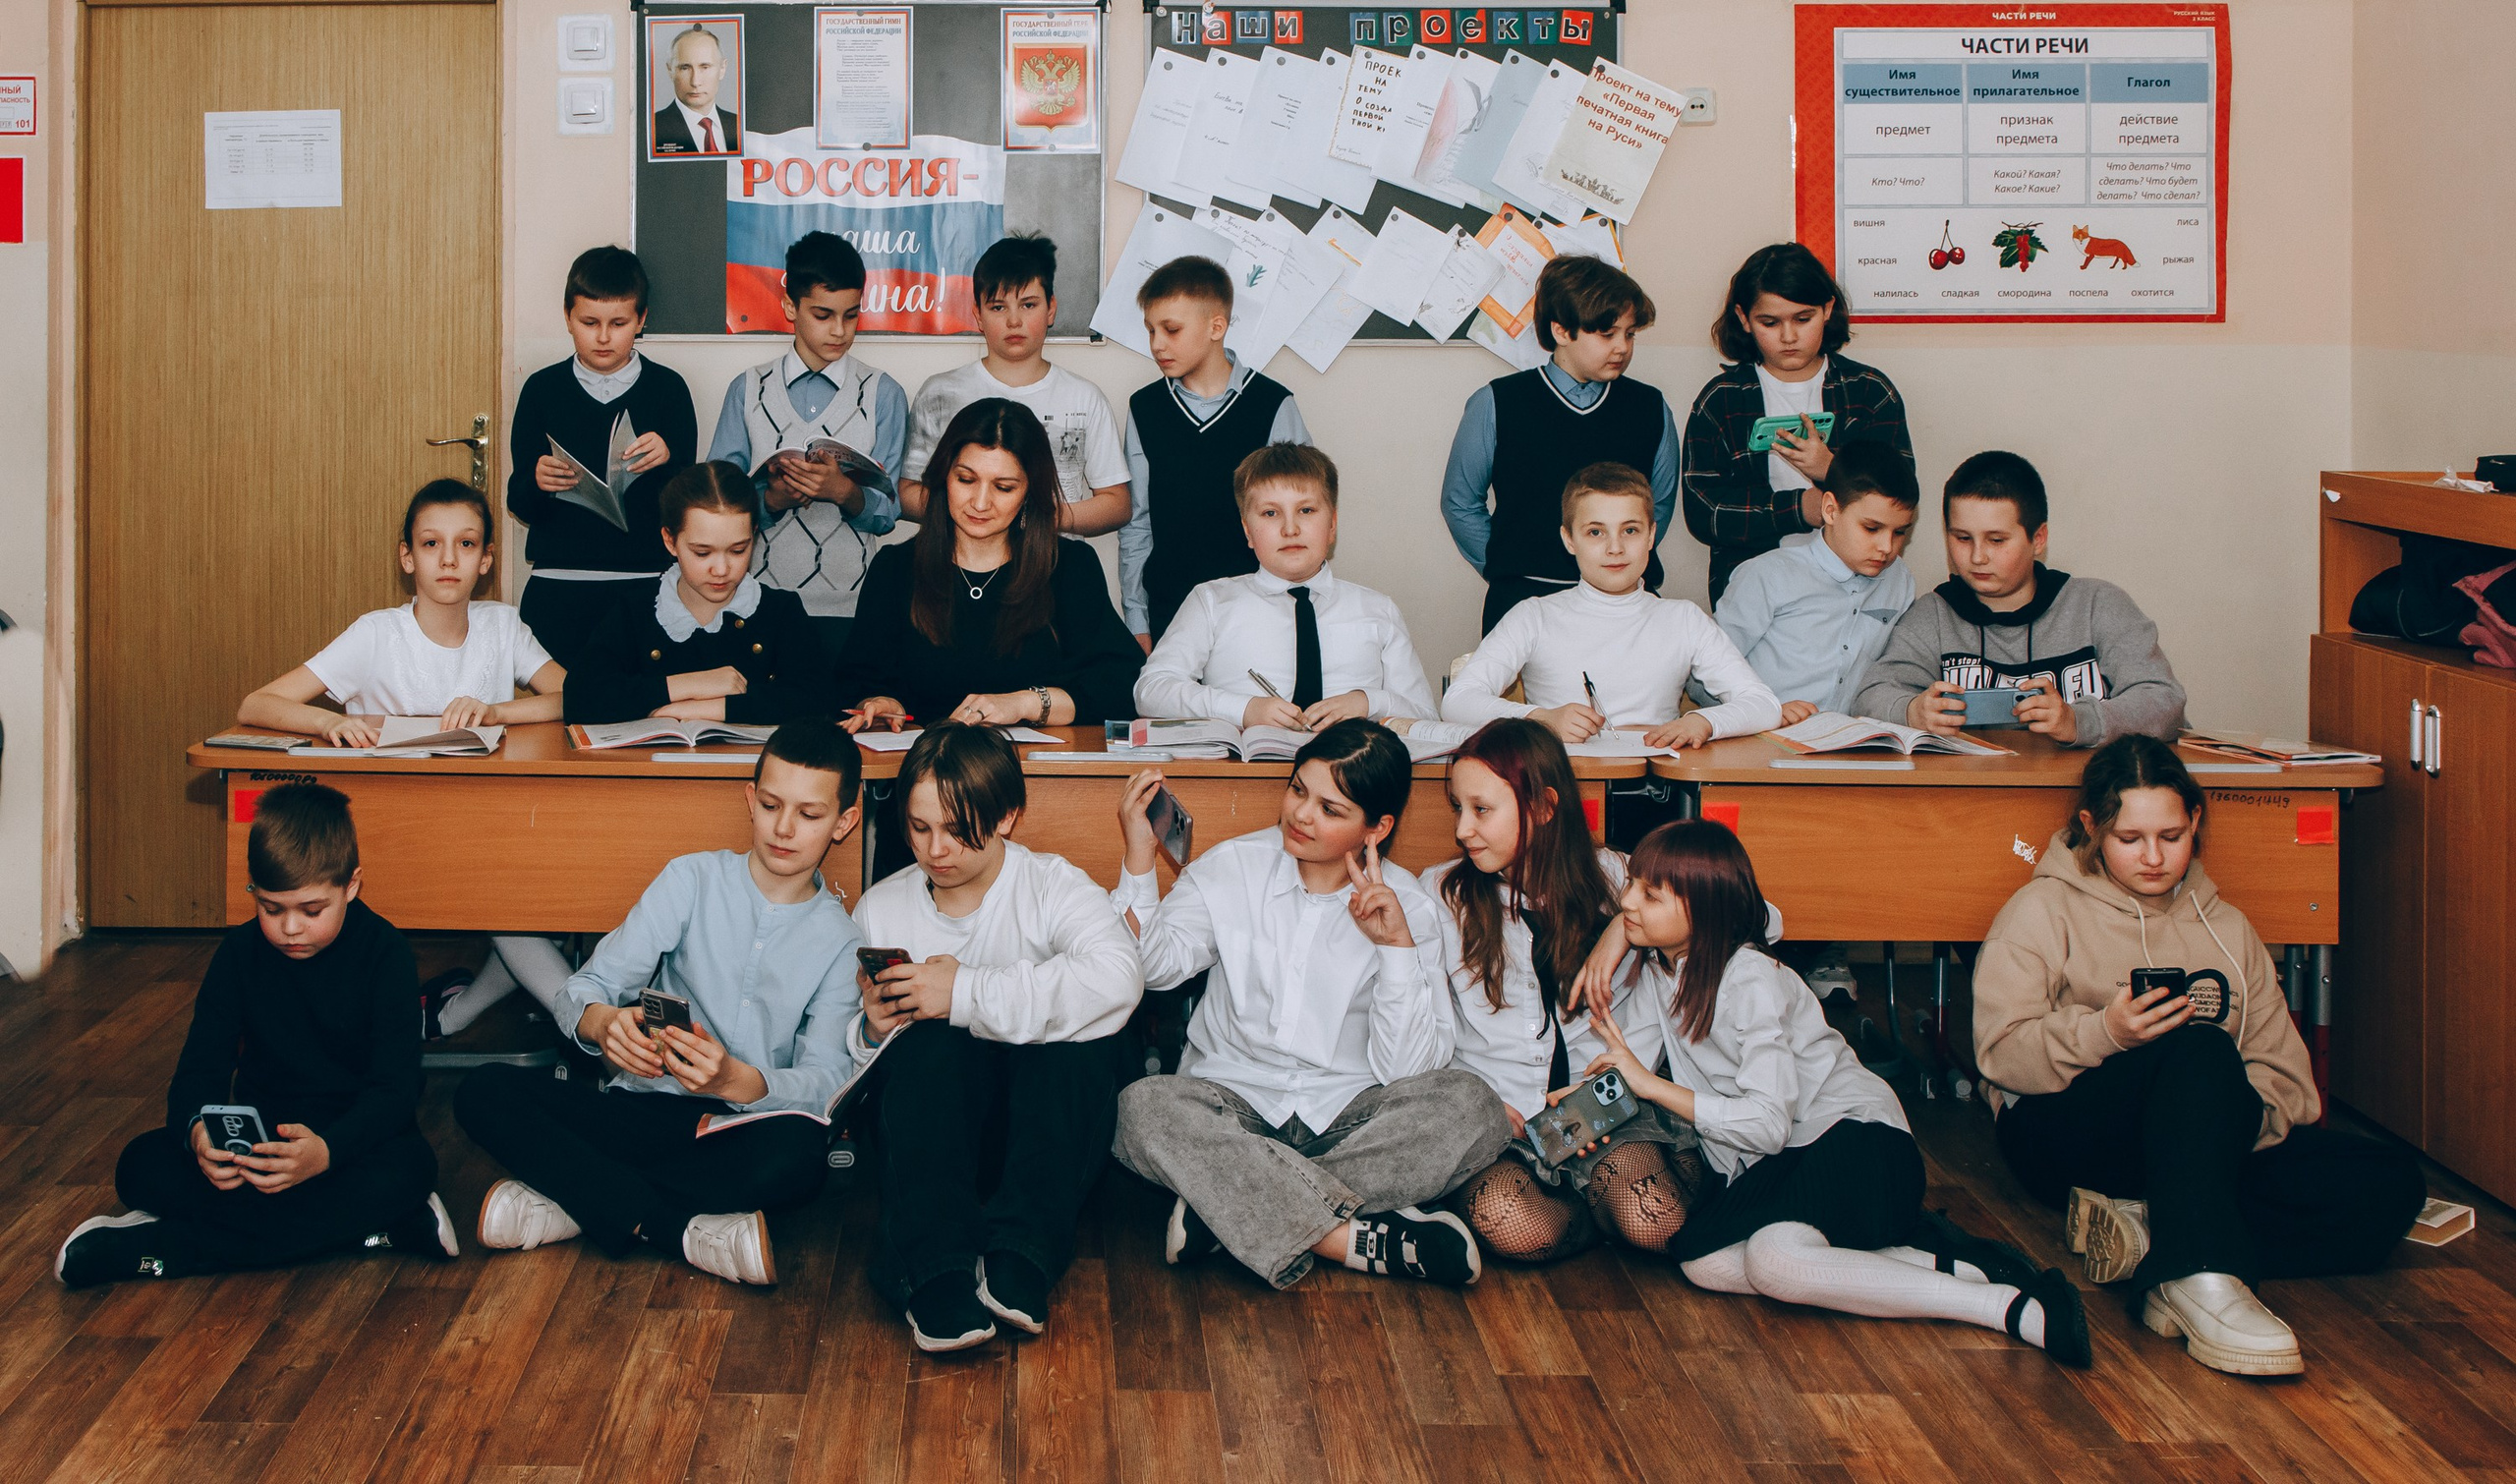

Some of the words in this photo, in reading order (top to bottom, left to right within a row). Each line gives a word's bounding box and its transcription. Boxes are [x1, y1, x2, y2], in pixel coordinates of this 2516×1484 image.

[826, 17, 884, 26] ГОСУДАРСТВЕННЫЙ
[1991, 12, 2027, 21] ЧАСТИ
[2029, 12, 2057, 21] РЕЧИ
[1012, 19, 1072, 29] ГОСУДАРСТВЕННЫЙ
[1175, 12, 1298, 44] Наши
[1354, 14, 1590, 44] проекты
[826, 27, 865, 35] РОССИЙСКОЙ
[866, 27, 902, 35] ФЕДЕРАЦИИ
[1012, 29, 1053, 37] РОССИЙСКОЙ
[1961, 37, 2030, 54] ЧАСТИ
[2035, 37, 2089, 54] РЕЧИ
[1888, 69, 1916, 80] Имя
[2011, 69, 2039, 80] Имя
[1374, 77, 1387, 86] НА
[2127, 76, 2171, 87] Глагол
[0, 85, 22, 94] НЫЙ
[1357, 84, 1383, 96] ТЕМУ
[1589, 66, 1634, 93] Проект
[1634, 89, 1651, 102] на
[1653, 96, 1683, 118] тему
[1845, 86, 1961, 98] существительное
[1973, 86, 2080, 98] прилагательное
[1355, 96, 1362, 105] О
[1602, 92, 1656, 122] «Первая
[1352, 109, 1384, 121] ПЕРВОЙ
[1575, 95, 1633, 128] печатная
[1634, 123, 1669, 144] книга
[2119, 113, 2179, 127] действие
[16, 119, 30, 129] 101
[2000, 115, 2054, 128] признак
[1587, 118, 1604, 132] на
[1605, 125, 1642, 149] Руси»
[1875, 125, 1931, 138] предмет
[1996, 135, 2058, 146] предмета
[2118, 135, 2180, 146] предмета
[2106, 162, 2127, 171] Что
[2128, 161, 2169, 171] делать?
[2170, 162, 2192, 171] Что
[1993, 169, 2028, 179] Какой?
[2028, 169, 2061, 179] Какая?
[1871, 177, 1898, 187] Кто?
[1899, 177, 1925, 187] Что?
[2098, 176, 2144, 186] сделать?
[2145, 176, 2166, 186] Что
[2167, 175, 2199, 187] будет
[1994, 184, 2028, 194] Какое?
[2028, 184, 2061, 194] Какие?
[2096, 191, 2138, 200] делать?
[2141, 191, 2162, 200] Что
[2163, 190, 2201, 200] сделал?
[824, 229, 921, 255] аша
[1858, 257, 1898, 265] красная
[2162, 256, 2195, 265] рыжая
[1873, 289, 1919, 298] налилась
[1941, 289, 1980, 299] сладкая
[1997, 289, 2052, 299] смородина
[2069, 289, 2109, 298] поспела
[1957, 656, 1981, 665] stop!
